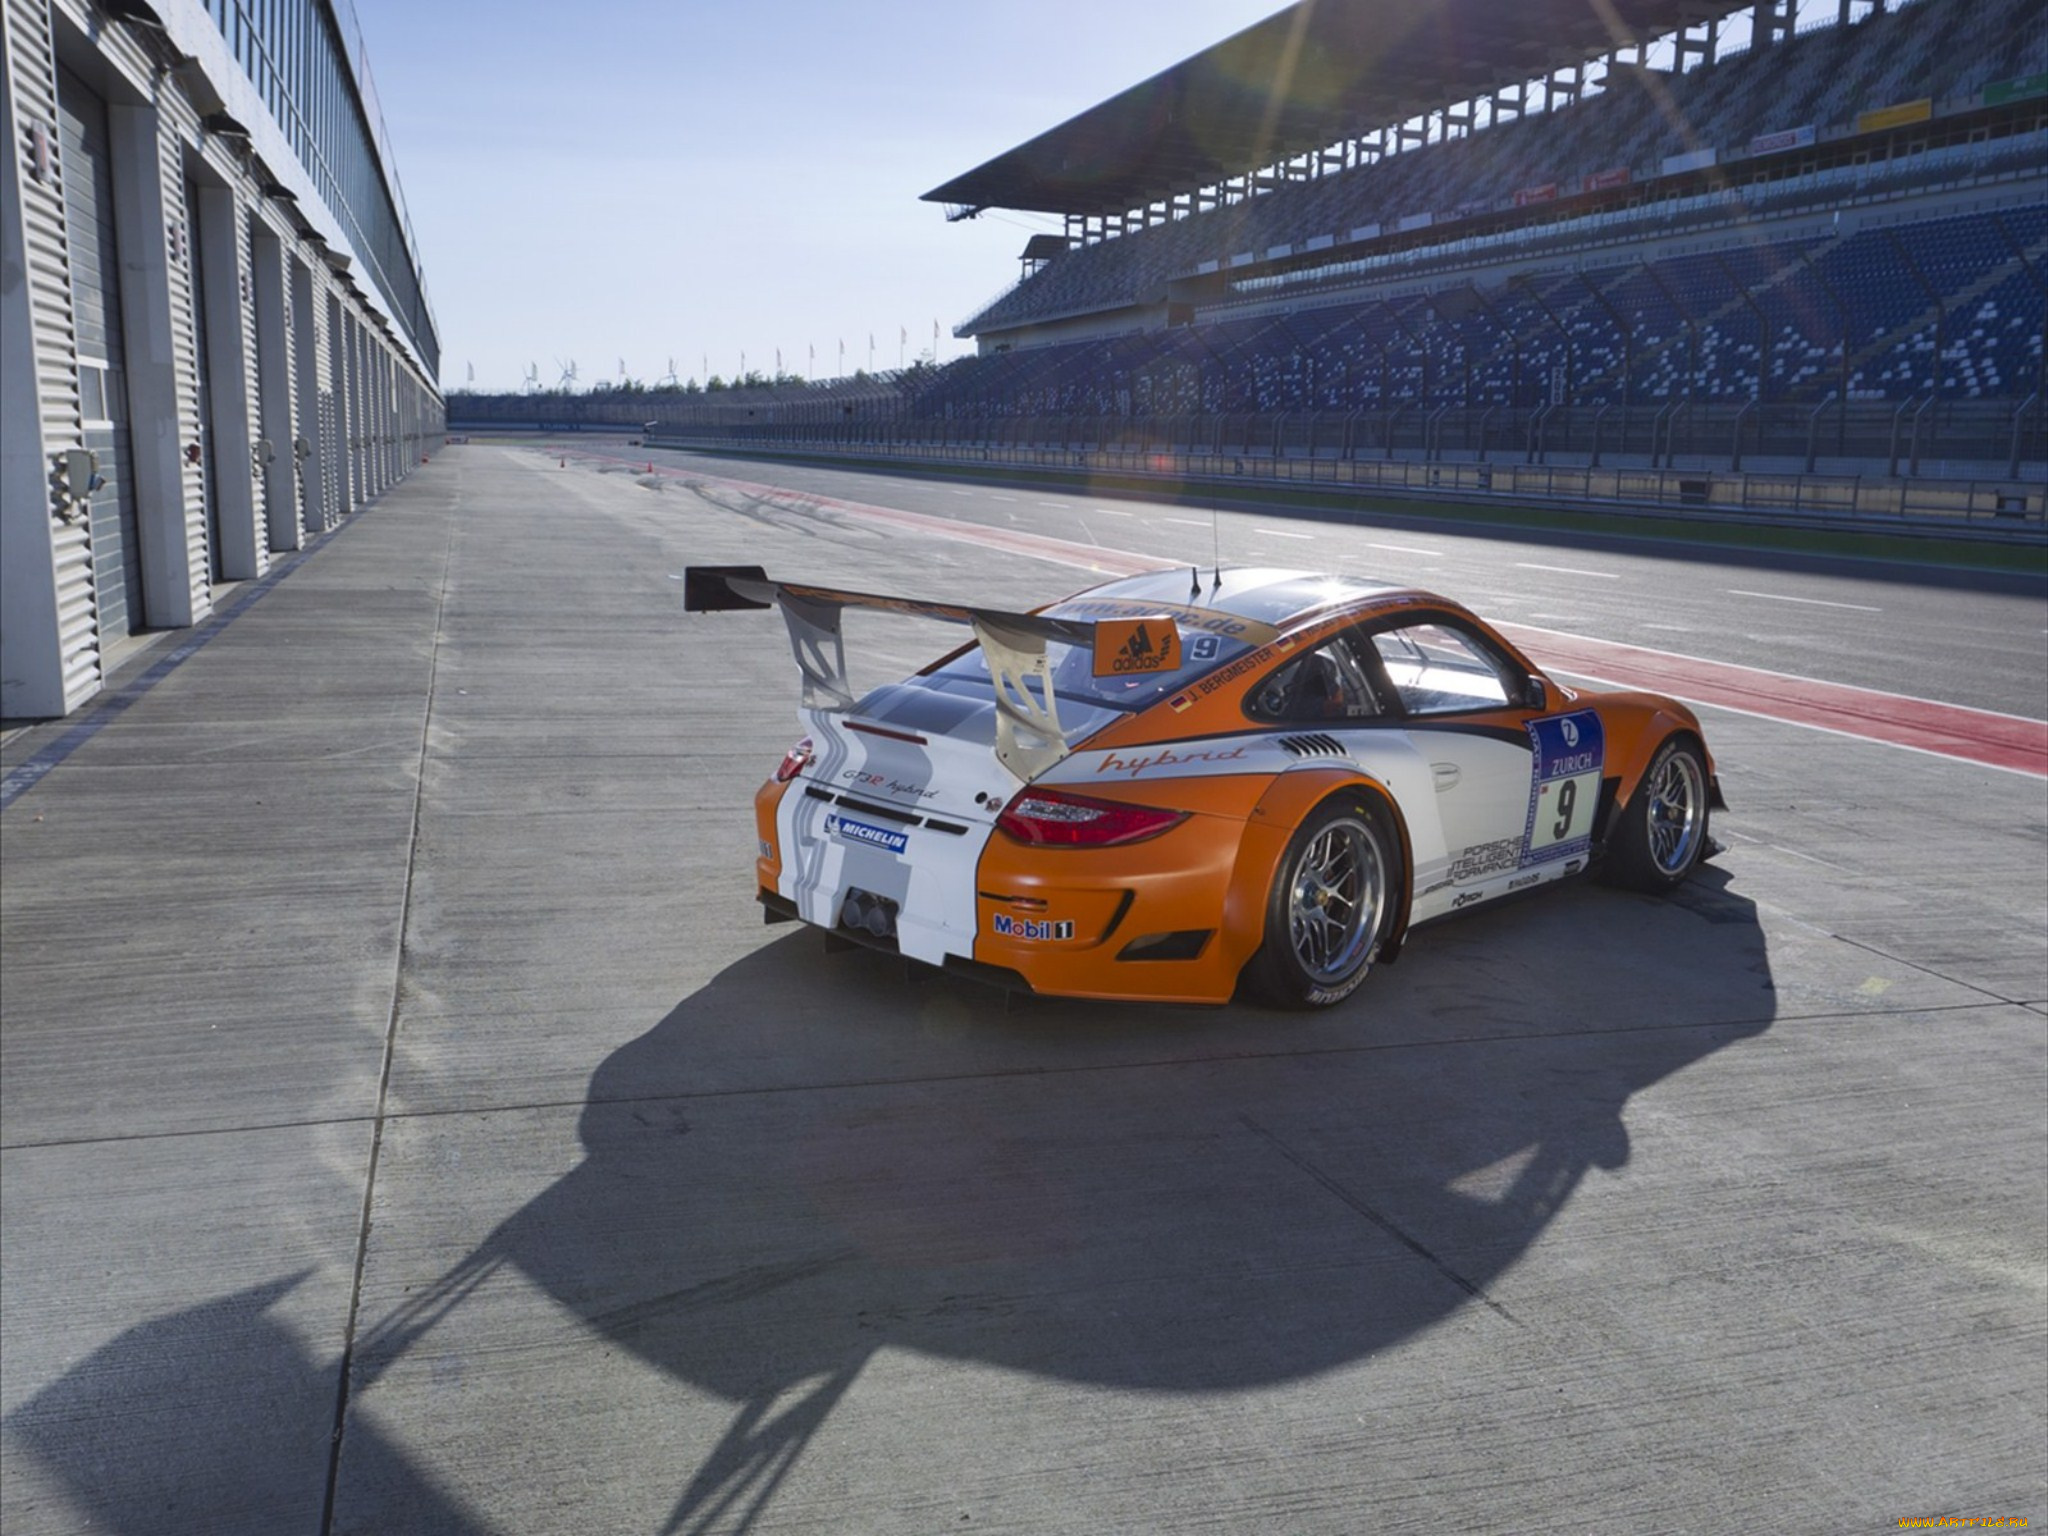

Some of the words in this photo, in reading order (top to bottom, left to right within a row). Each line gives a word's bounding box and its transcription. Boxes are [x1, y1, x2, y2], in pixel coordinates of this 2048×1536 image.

[1194, 637, 1219, 659] 9
[1113, 654, 1160, 672] adidas
[1200, 648, 1274, 695] BERGMEISTER
[1096, 748, 1248, 777] hybrid
[1552, 753, 1592, 776] ZURICH
[1553, 779, 1577, 840] 9
[842, 822, 906, 848] MICHELIN
[1463, 836, 1524, 857] PORSCHE
[995, 914, 1050, 939] Mobil
